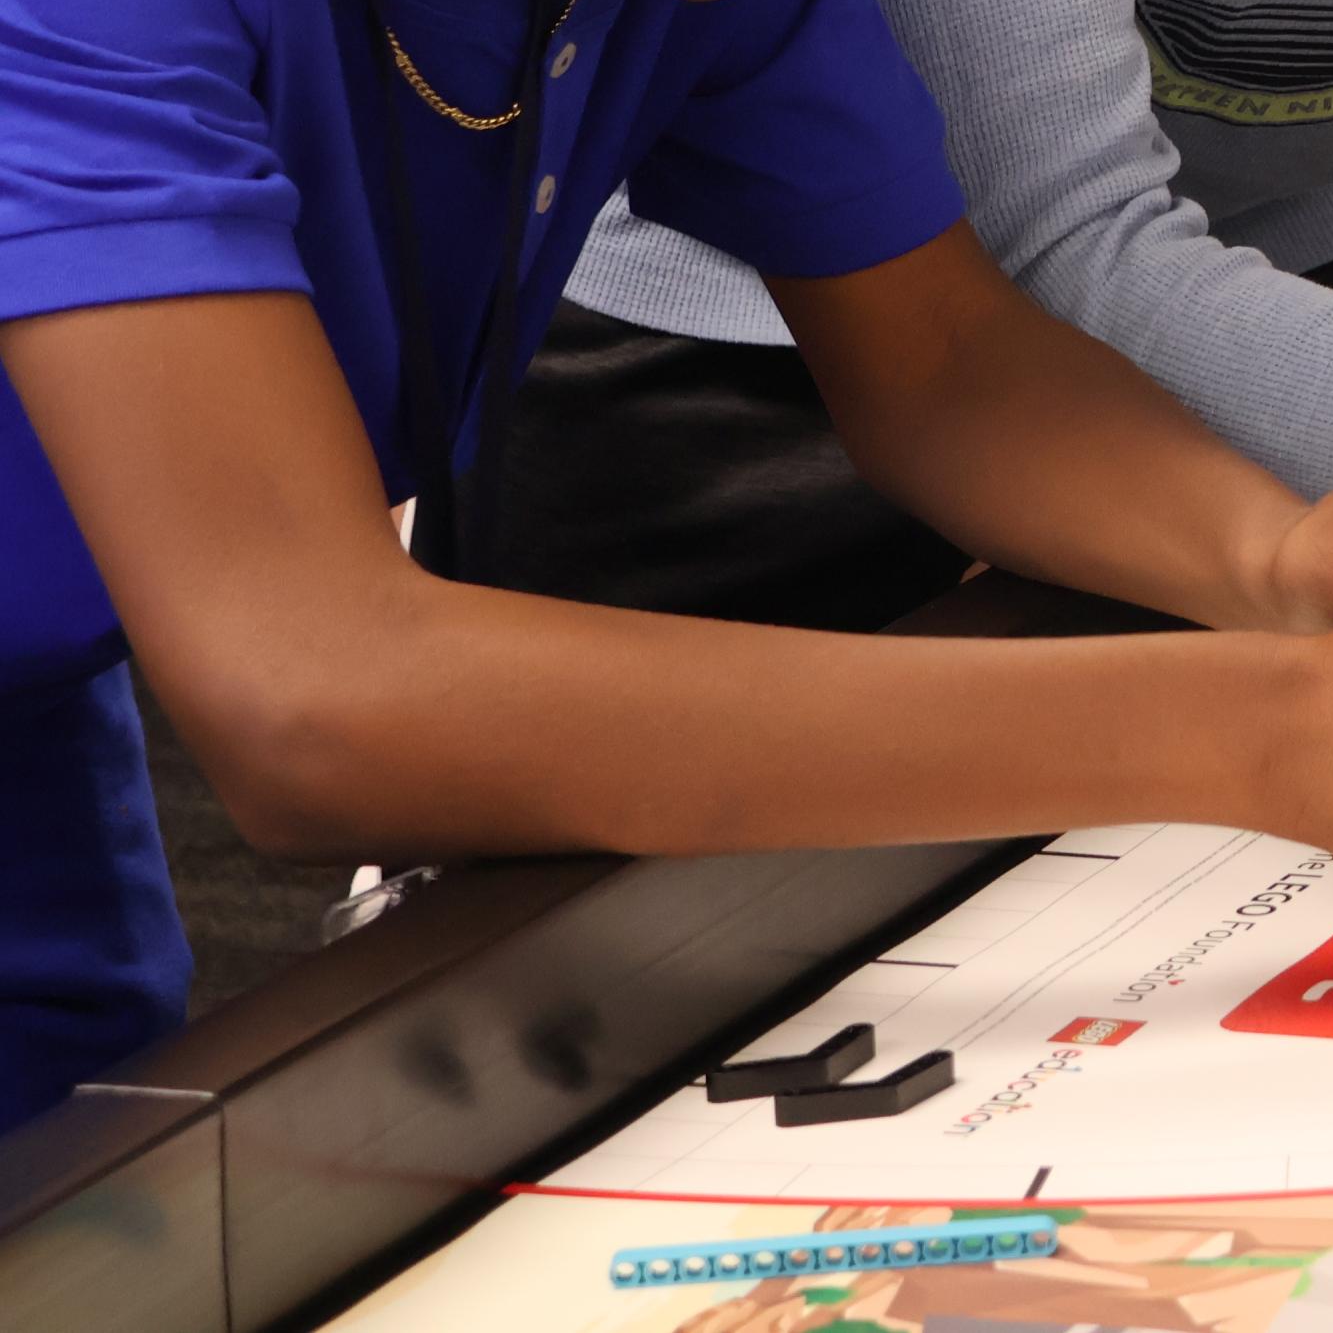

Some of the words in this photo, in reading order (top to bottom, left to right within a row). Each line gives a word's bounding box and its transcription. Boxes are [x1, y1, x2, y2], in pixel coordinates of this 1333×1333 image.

[1235, 871, 1323, 918] LEGO
[1112, 918, 1256, 1004] Foundation
[943, 1047, 1083, 1138] education
